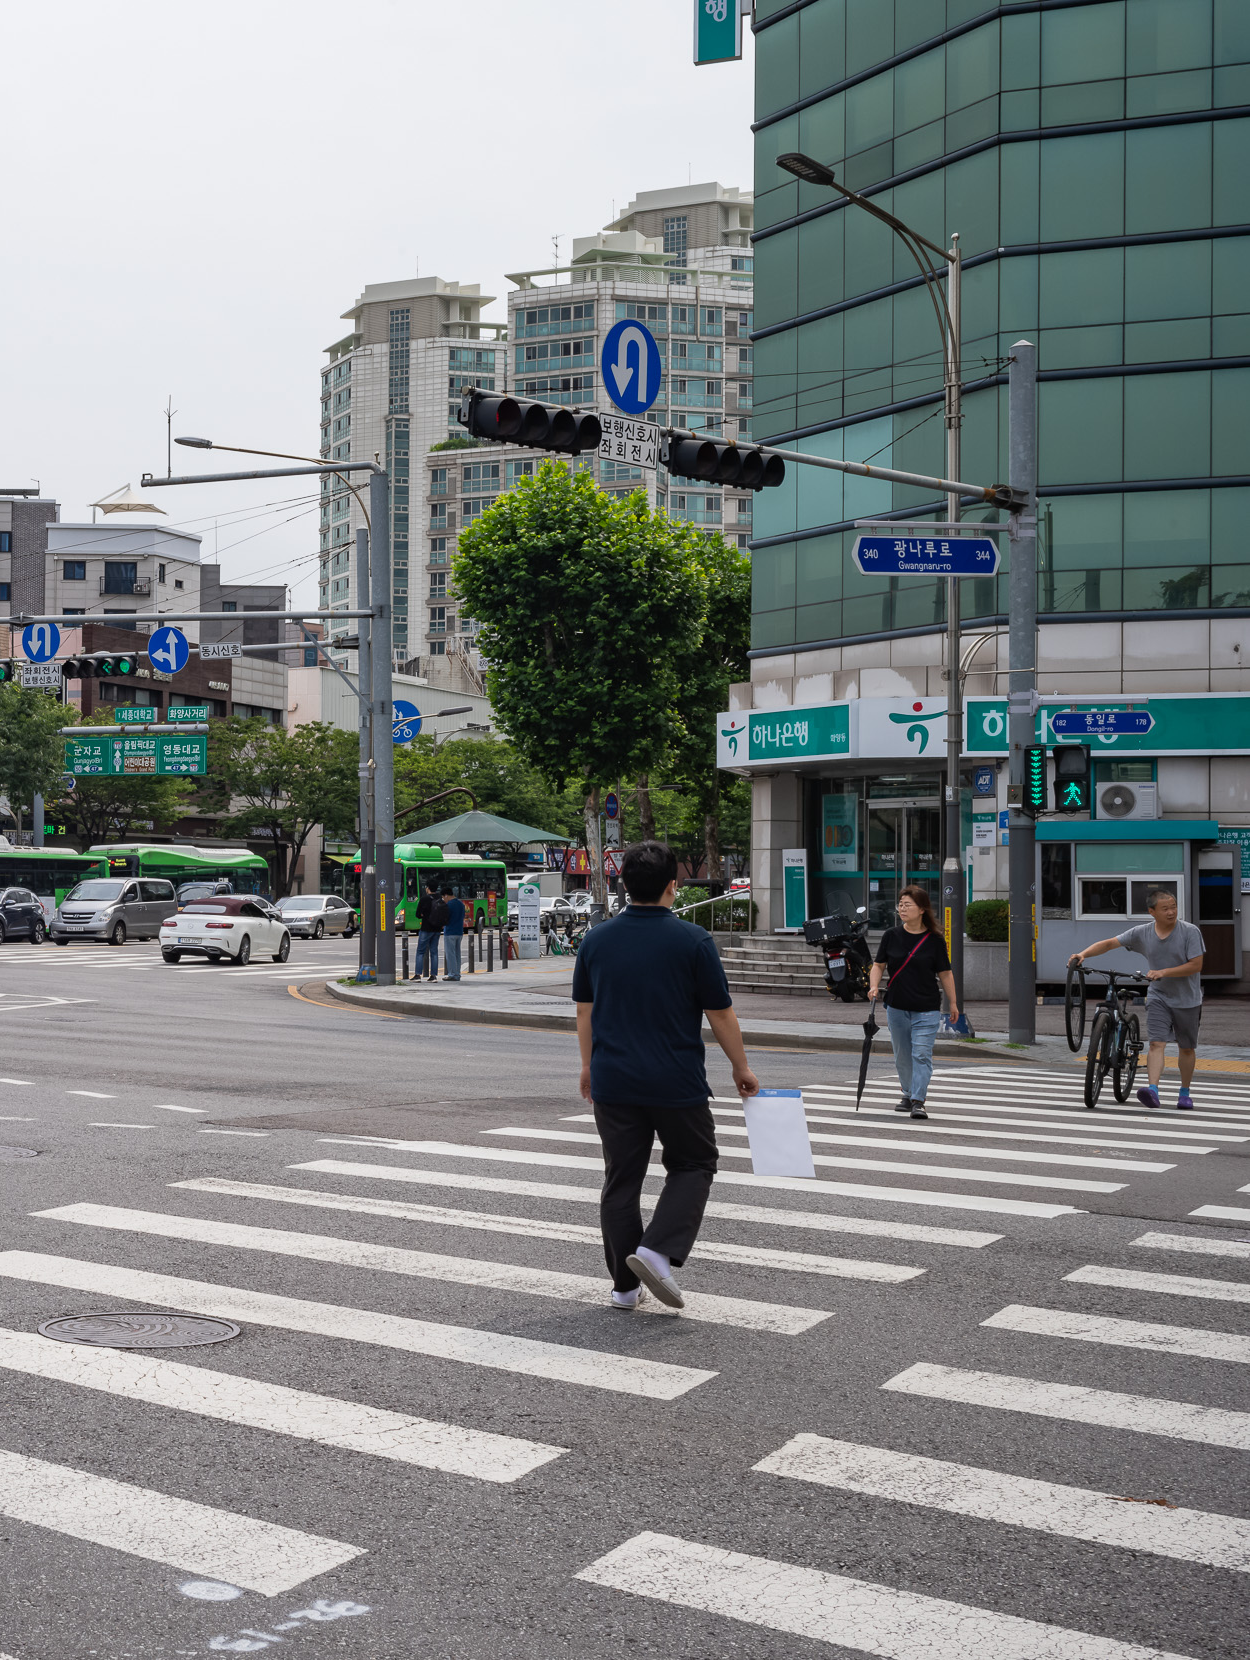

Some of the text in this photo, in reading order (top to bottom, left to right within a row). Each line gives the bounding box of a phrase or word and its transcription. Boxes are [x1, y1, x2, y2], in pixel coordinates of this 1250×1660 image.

[601, 418, 657, 446] 보행신호시
[601, 439, 656, 465] 좌회전시
[863, 540, 990, 561] 340 광나루로 344
[898, 561, 952, 572] Gwangnaru-ro
[201, 645, 241, 657] 동시신호
[24, 666, 60, 675] 좌회전시
[24, 676, 60, 685] 보행신호시
[121, 709, 153, 721] 세종대학교
[170, 708, 206, 719] 화양사거리
[1056, 714, 1147, 727] 182 동일로 178
[1087, 725, 1114, 733] Dongil-ro
[753, 721, 809, 749] 하나은행
[74, 746, 102, 756] 군자교
[163, 744, 201, 755] 영동대교
